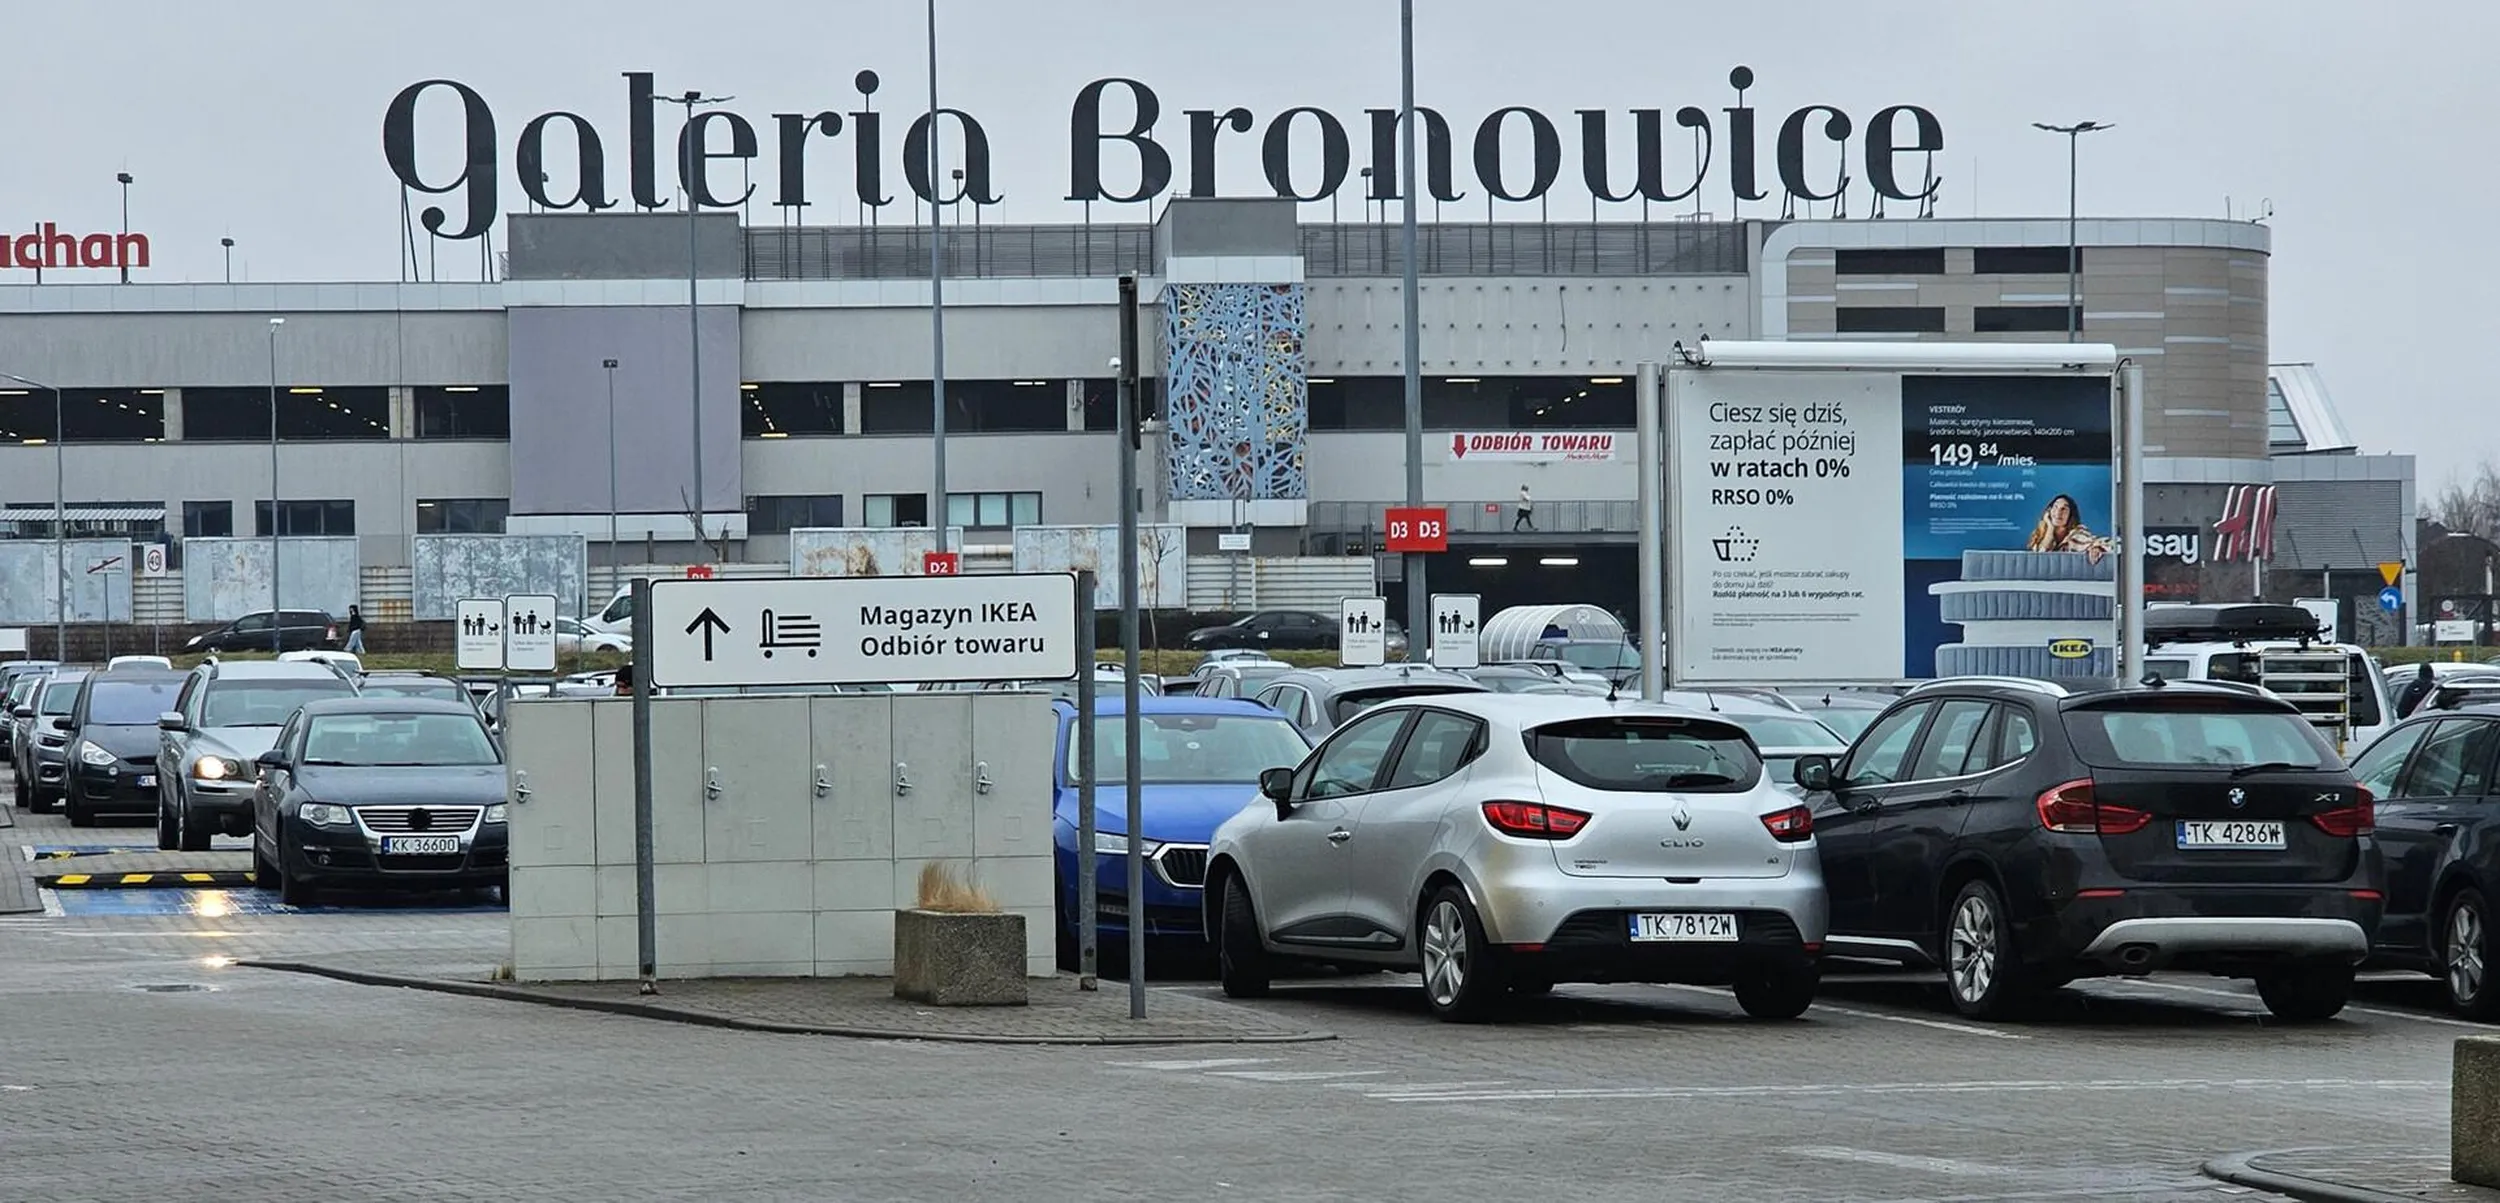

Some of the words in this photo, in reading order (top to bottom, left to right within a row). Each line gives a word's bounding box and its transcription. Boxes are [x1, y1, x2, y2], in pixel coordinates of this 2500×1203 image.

[383, 69, 1004, 239] galeria
[1064, 66, 1943, 203] Bronowice
[1710, 402, 1762, 423] Ciesz
[1769, 403, 1796, 427] się
[1804, 402, 1847, 426] dziś,
[1471, 431, 1533, 450] ODBIÓR
[1542, 435, 1612, 450] TOWARU
[1710, 430, 1776, 455] zapłać
[1784, 430, 1855, 456] później
[1711, 461, 1730, 477] w
[1737, 458, 1808, 478] ratach
[1816, 459, 1850, 478] 0%
[1712, 490, 1760, 505] RRSO
[1766, 490, 1794, 505] 0%
[1391, 521, 1408, 539] D3
[1419, 521, 1440, 538] D3
[149, 555, 160, 567] 40
[930, 562, 948, 573] D2
[861, 606, 972, 631] Magazyn
[982, 602, 1037, 623] IKEA
[861, 635, 947, 656] Odbiór
[955, 637, 1044, 654] towaru
[2052, 644, 2089, 653] IKEA
[2314, 793, 2340, 802] X1
[2190, 824, 2214, 843] TK
[2222, 824, 2280, 843] 4286W
[392, 839, 409, 851] KK
[415, 839, 455, 851] 36600
[1660, 839, 1704, 848] CLIO
[1642, 916, 1666, 935] TK
[1673, 916, 1731, 935] 7812W
